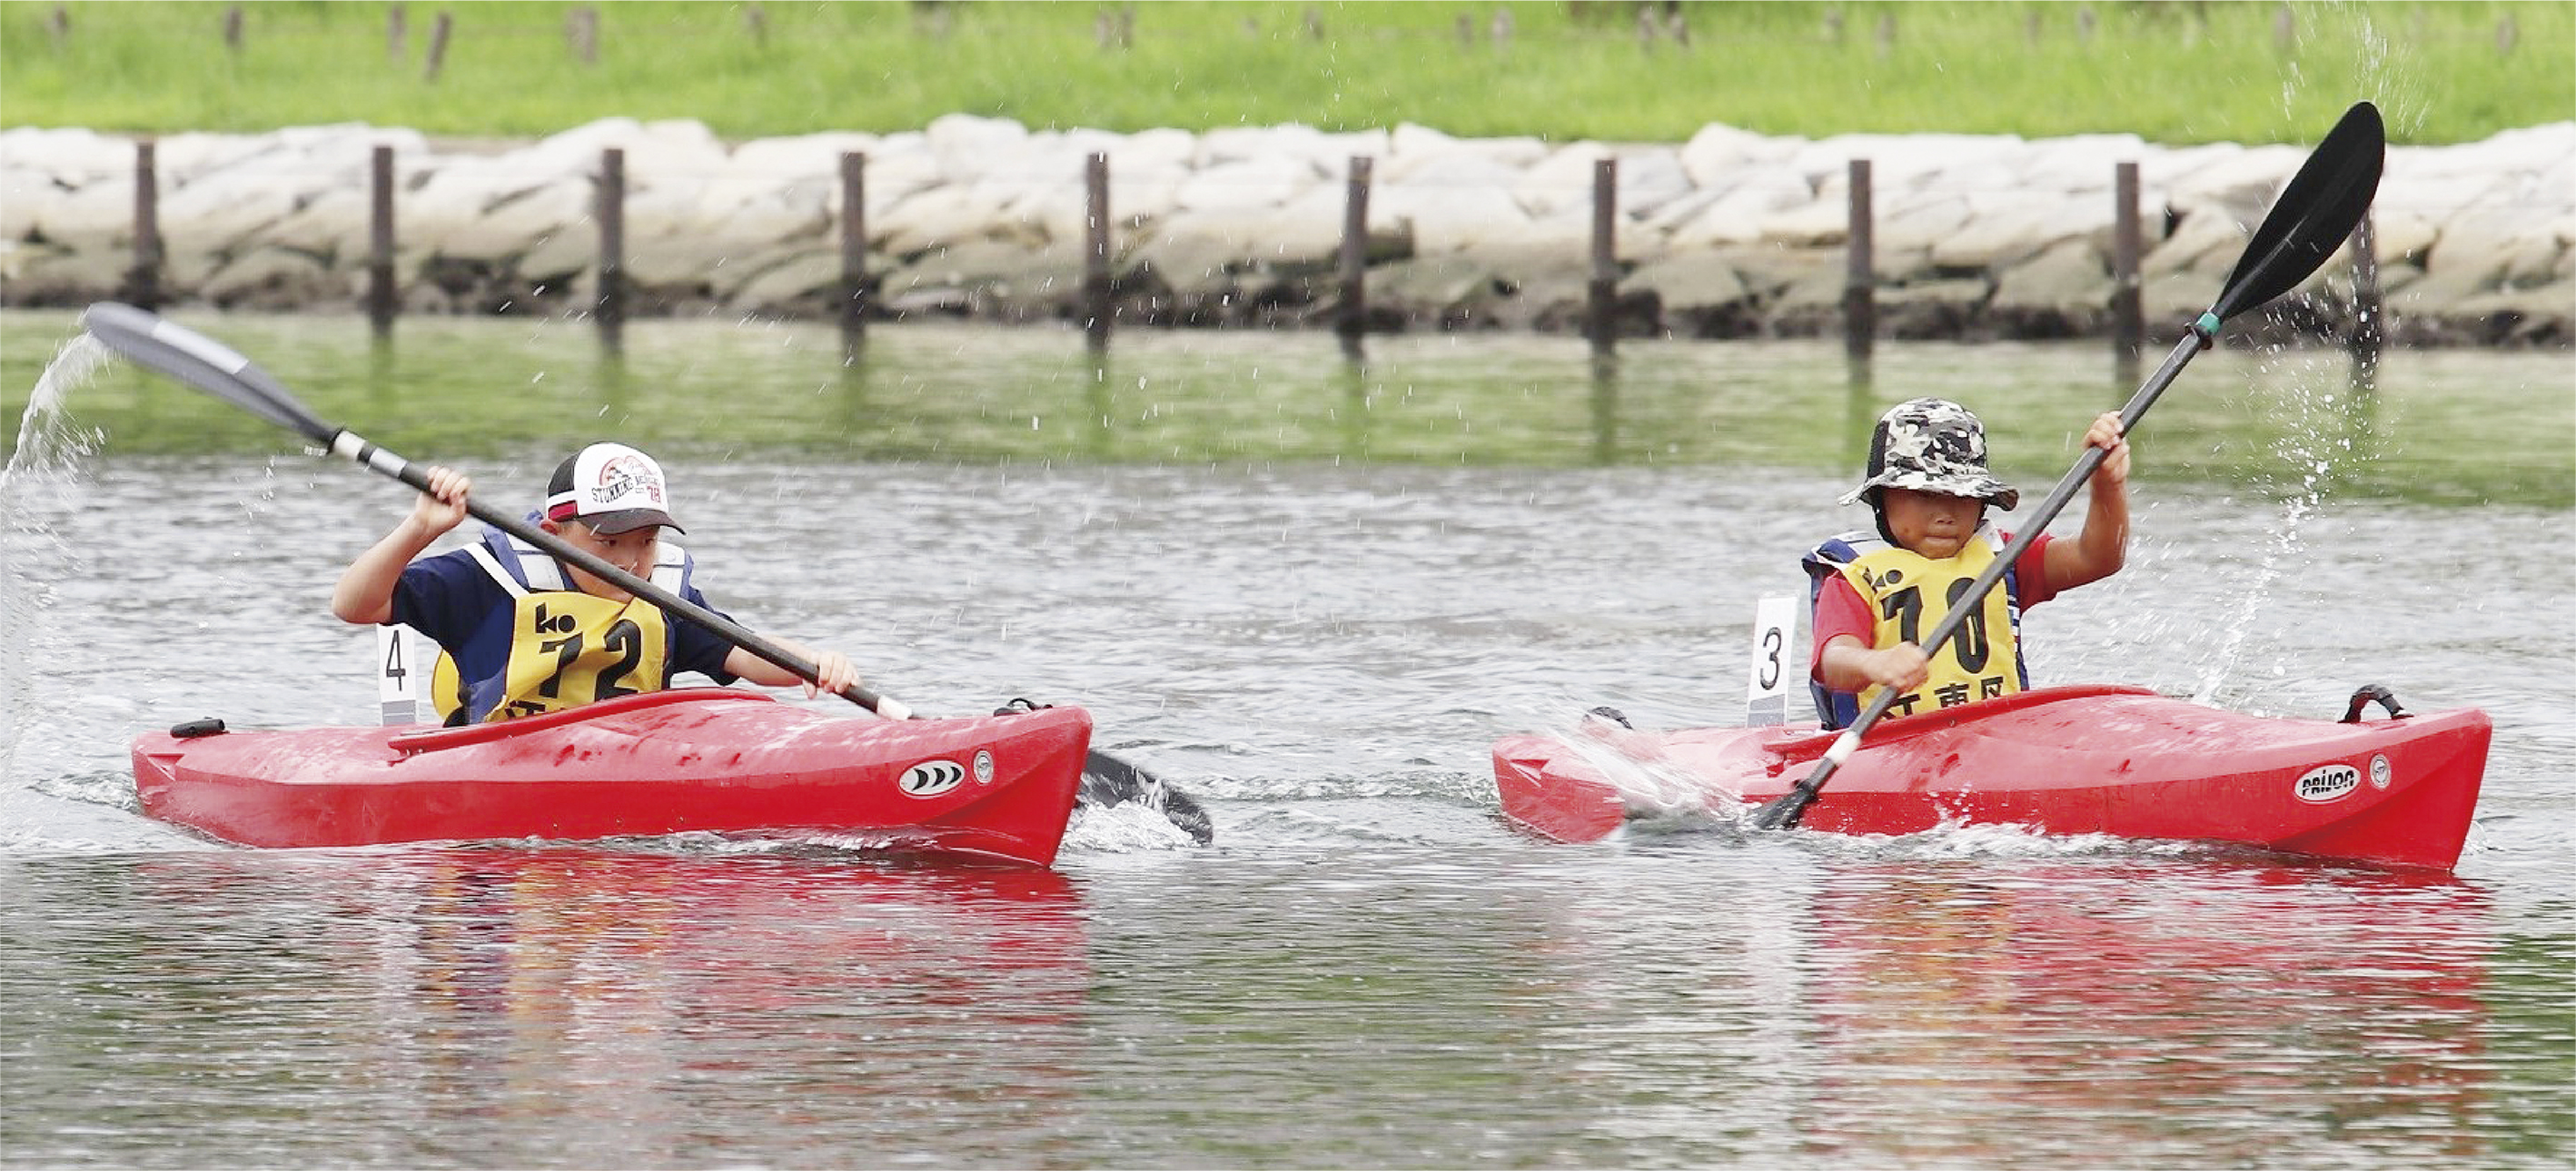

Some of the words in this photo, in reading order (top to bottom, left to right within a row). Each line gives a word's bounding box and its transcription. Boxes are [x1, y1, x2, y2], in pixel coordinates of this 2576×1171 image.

[386, 630, 406, 691] 4
[540, 619, 639, 701] 72
[1759, 626, 1782, 690] 3
[1880, 576, 1989, 674] 70
